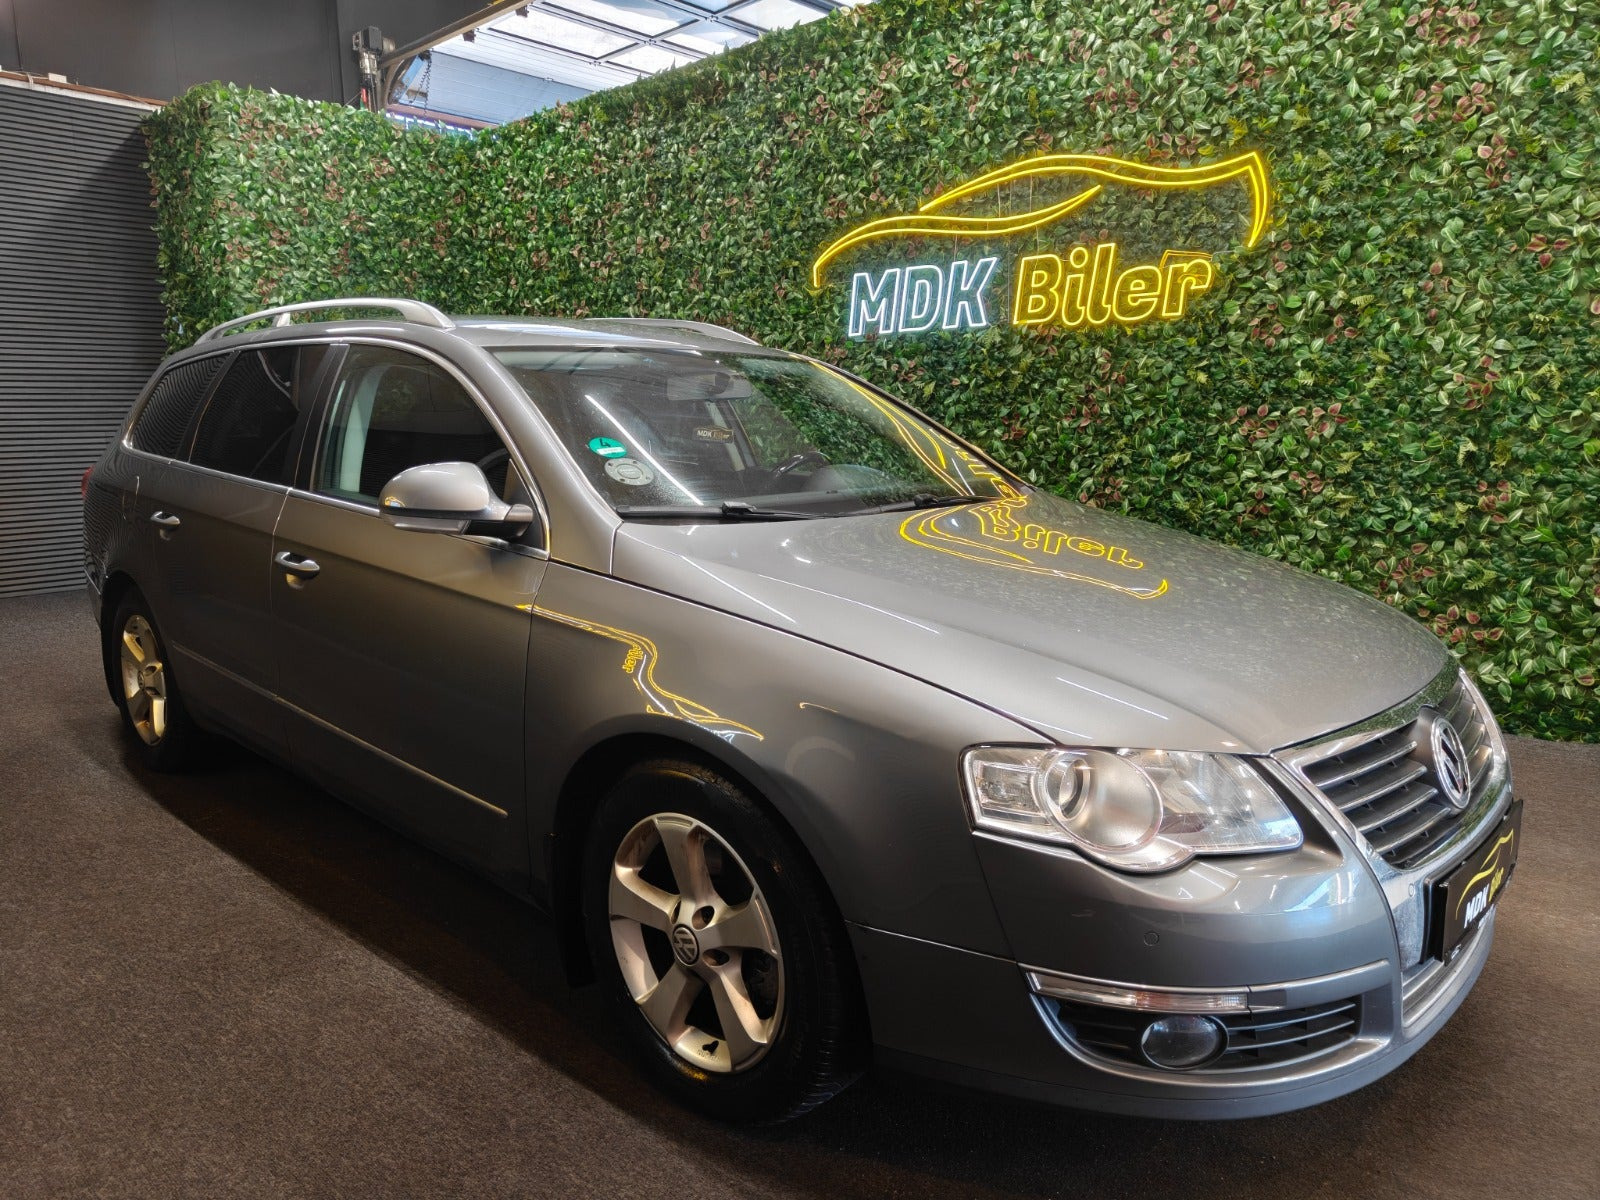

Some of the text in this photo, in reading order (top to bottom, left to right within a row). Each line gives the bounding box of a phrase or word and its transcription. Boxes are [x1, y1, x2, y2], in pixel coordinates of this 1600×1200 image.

[848, 242, 1213, 337] MDK Biler
[697, 430, 712, 438] MDK
